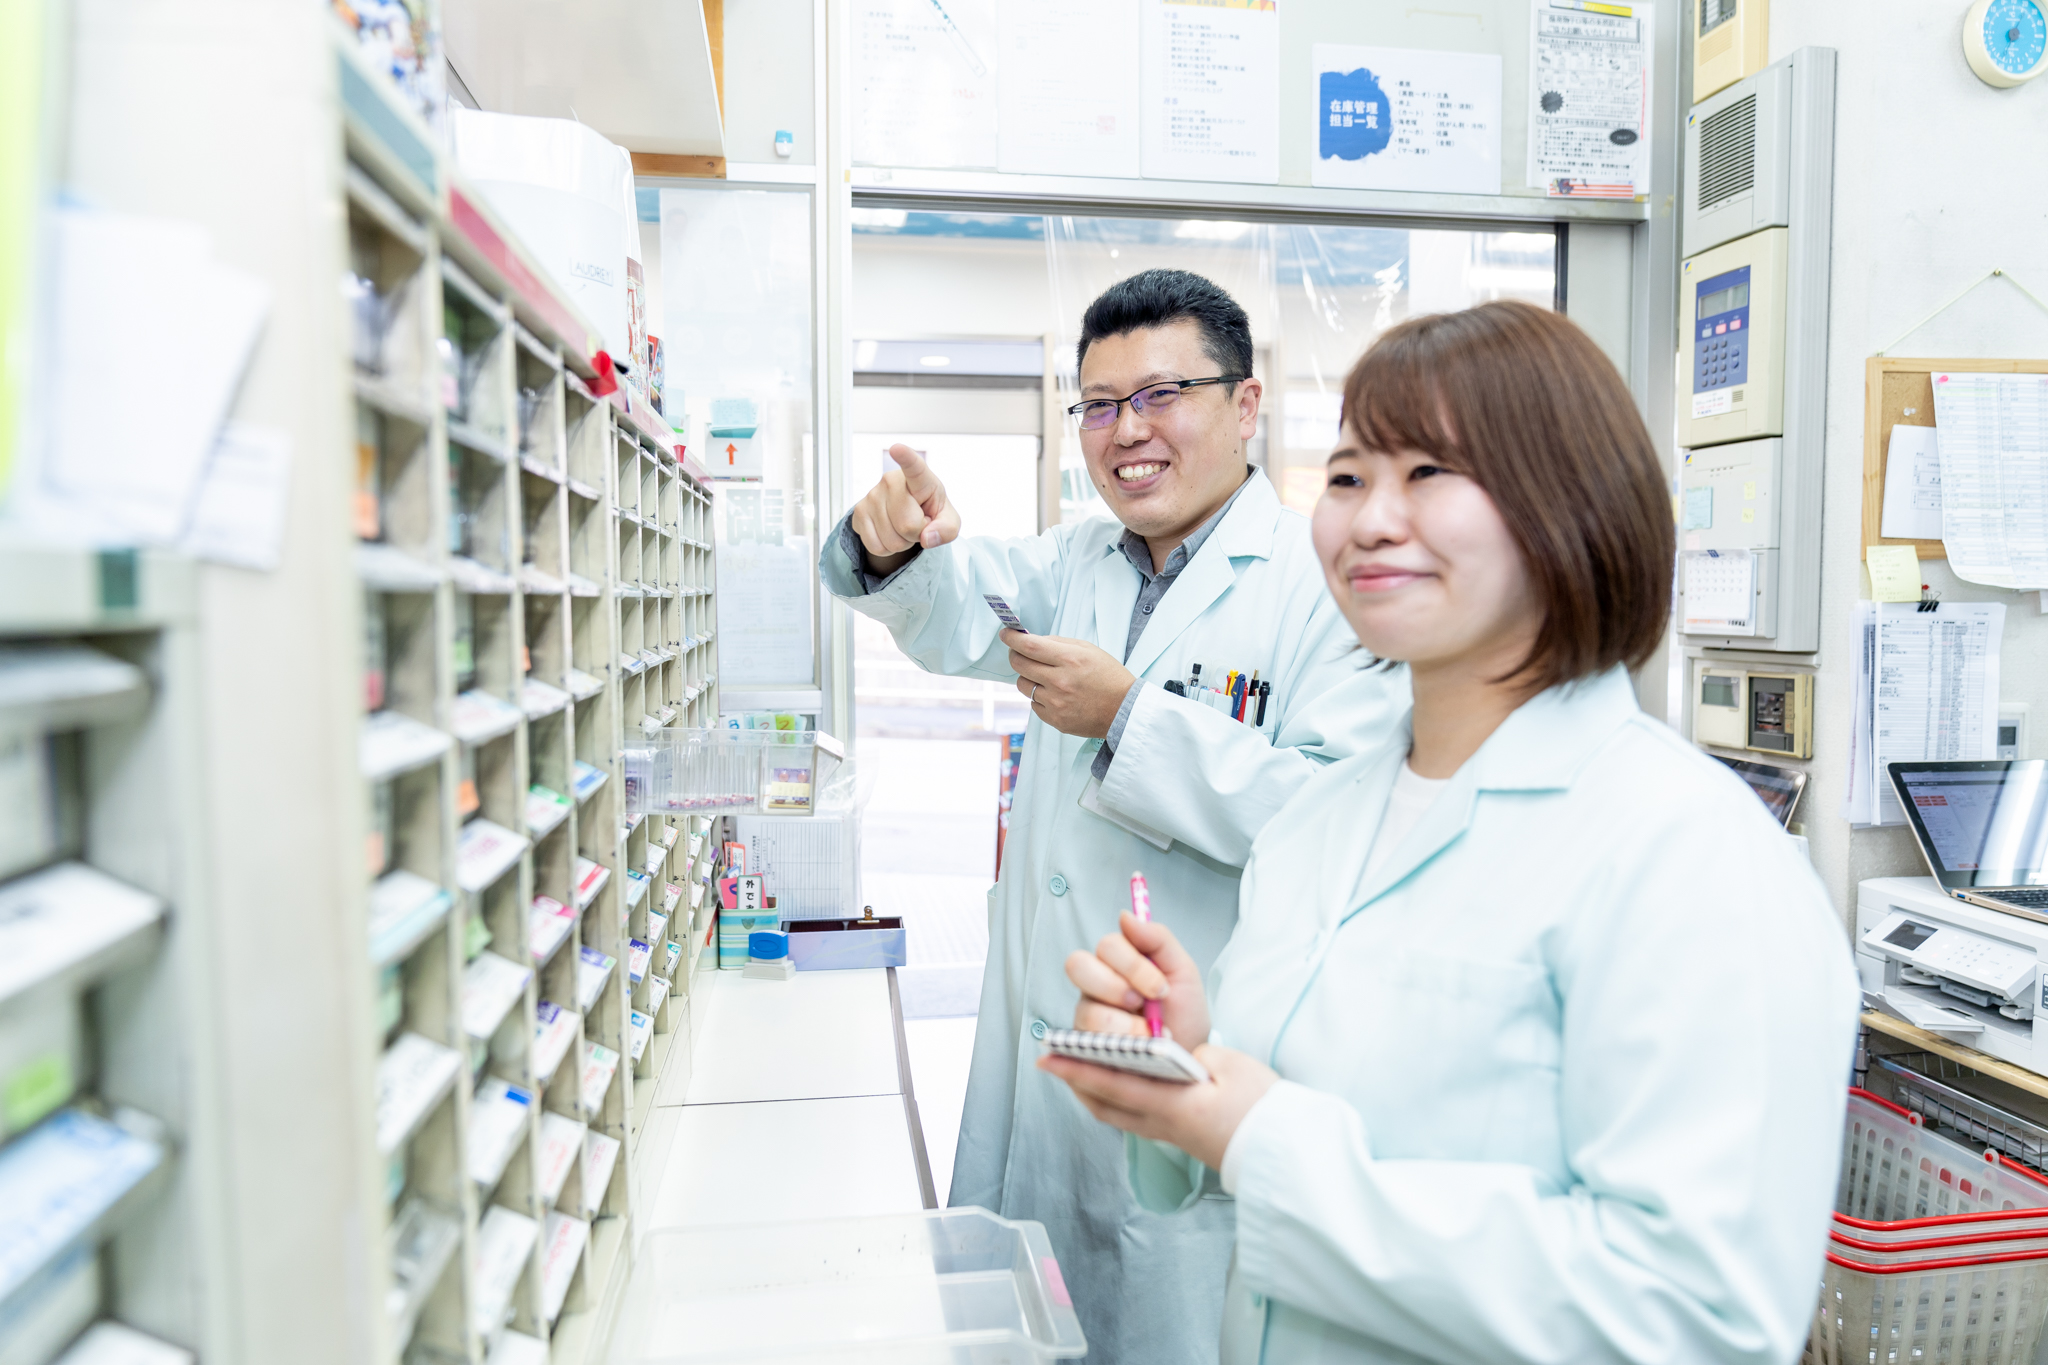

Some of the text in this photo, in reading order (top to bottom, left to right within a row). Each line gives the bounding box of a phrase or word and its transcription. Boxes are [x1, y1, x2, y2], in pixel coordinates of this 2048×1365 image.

[1330, 99, 1378, 116] 在庫管理
[1330, 114, 1378, 130] 担当一覧
[576, 262, 610, 281] AUDREY
